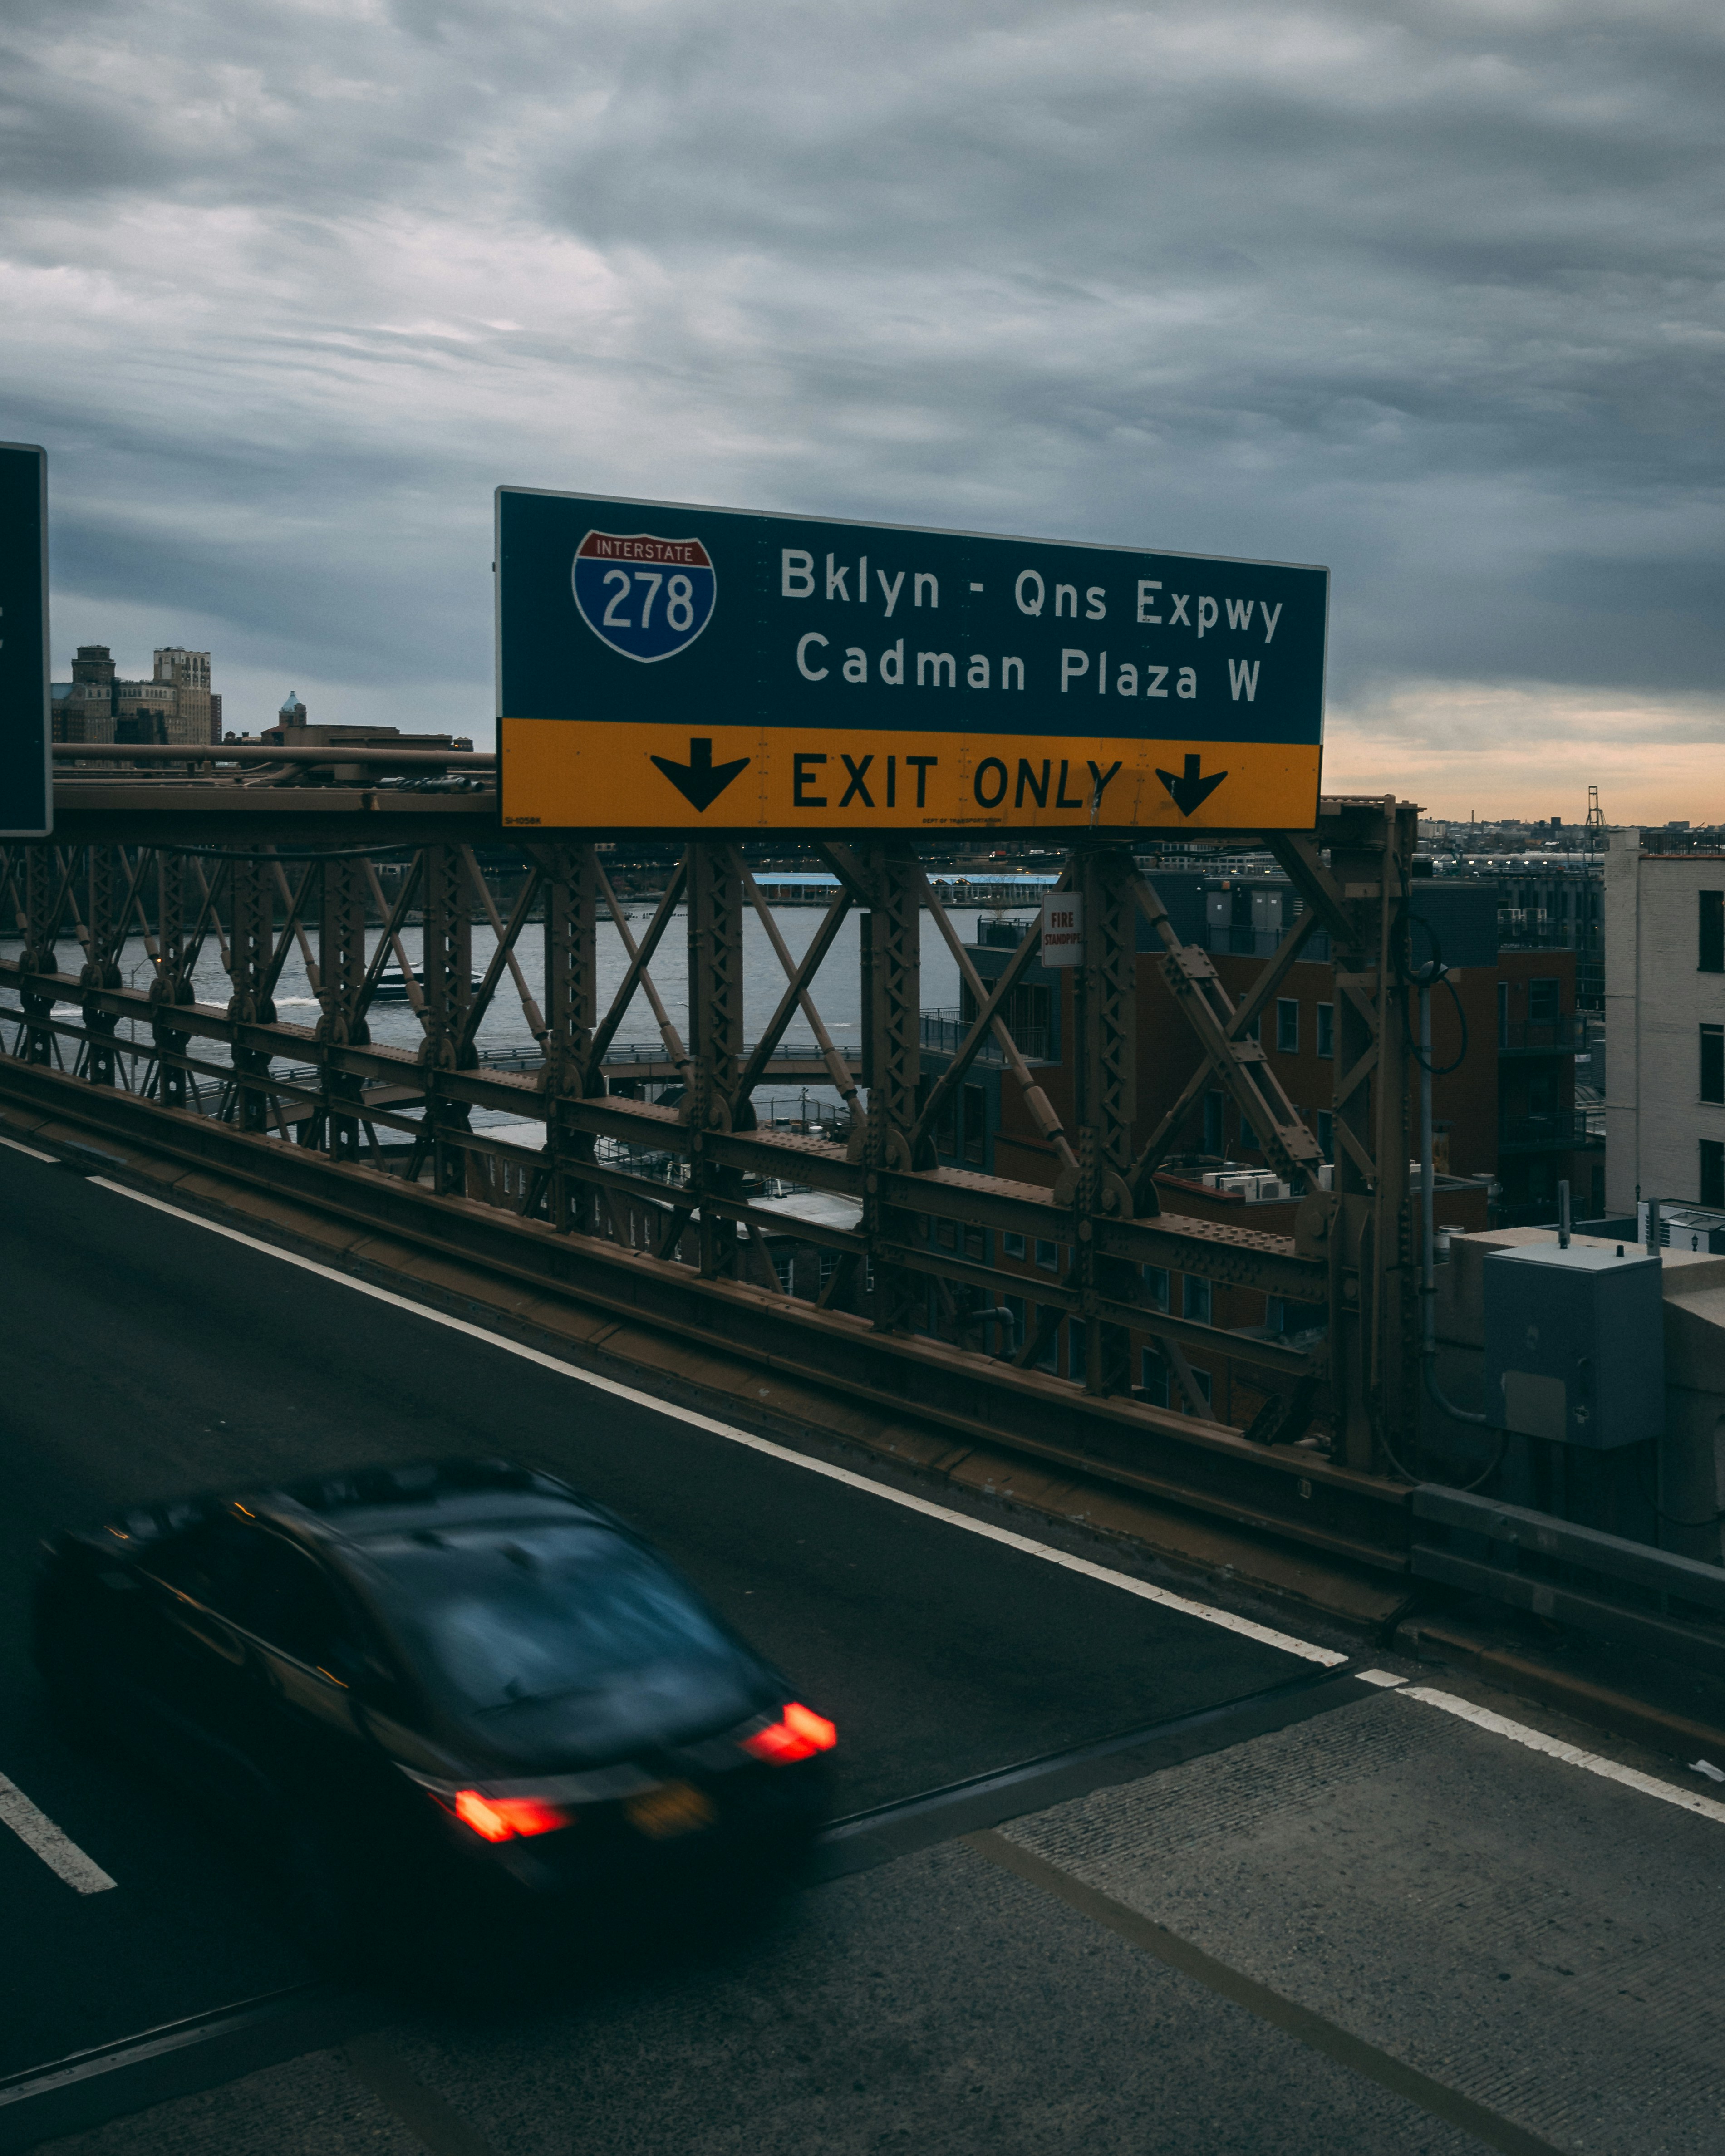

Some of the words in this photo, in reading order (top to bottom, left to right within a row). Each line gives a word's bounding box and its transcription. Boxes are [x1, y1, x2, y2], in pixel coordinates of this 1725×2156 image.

[597, 540, 693, 562] INTERSTATE
[603, 569, 694, 631] 278
[782, 548, 939, 617] Bklyn
[1015, 569, 1106, 620] Qns
[1137, 580, 1283, 643] Expwy
[796, 632, 1024, 690] Cadman
[1061, 648, 1197, 699] Plaza
[1228, 659, 1260, 702] W
[793, 753, 938, 808] EXIT
[973, 757, 1123, 810] ONLY
[1045, 933, 1081, 945] STANDPIPE
[1052, 912, 1074, 928] FIRE
